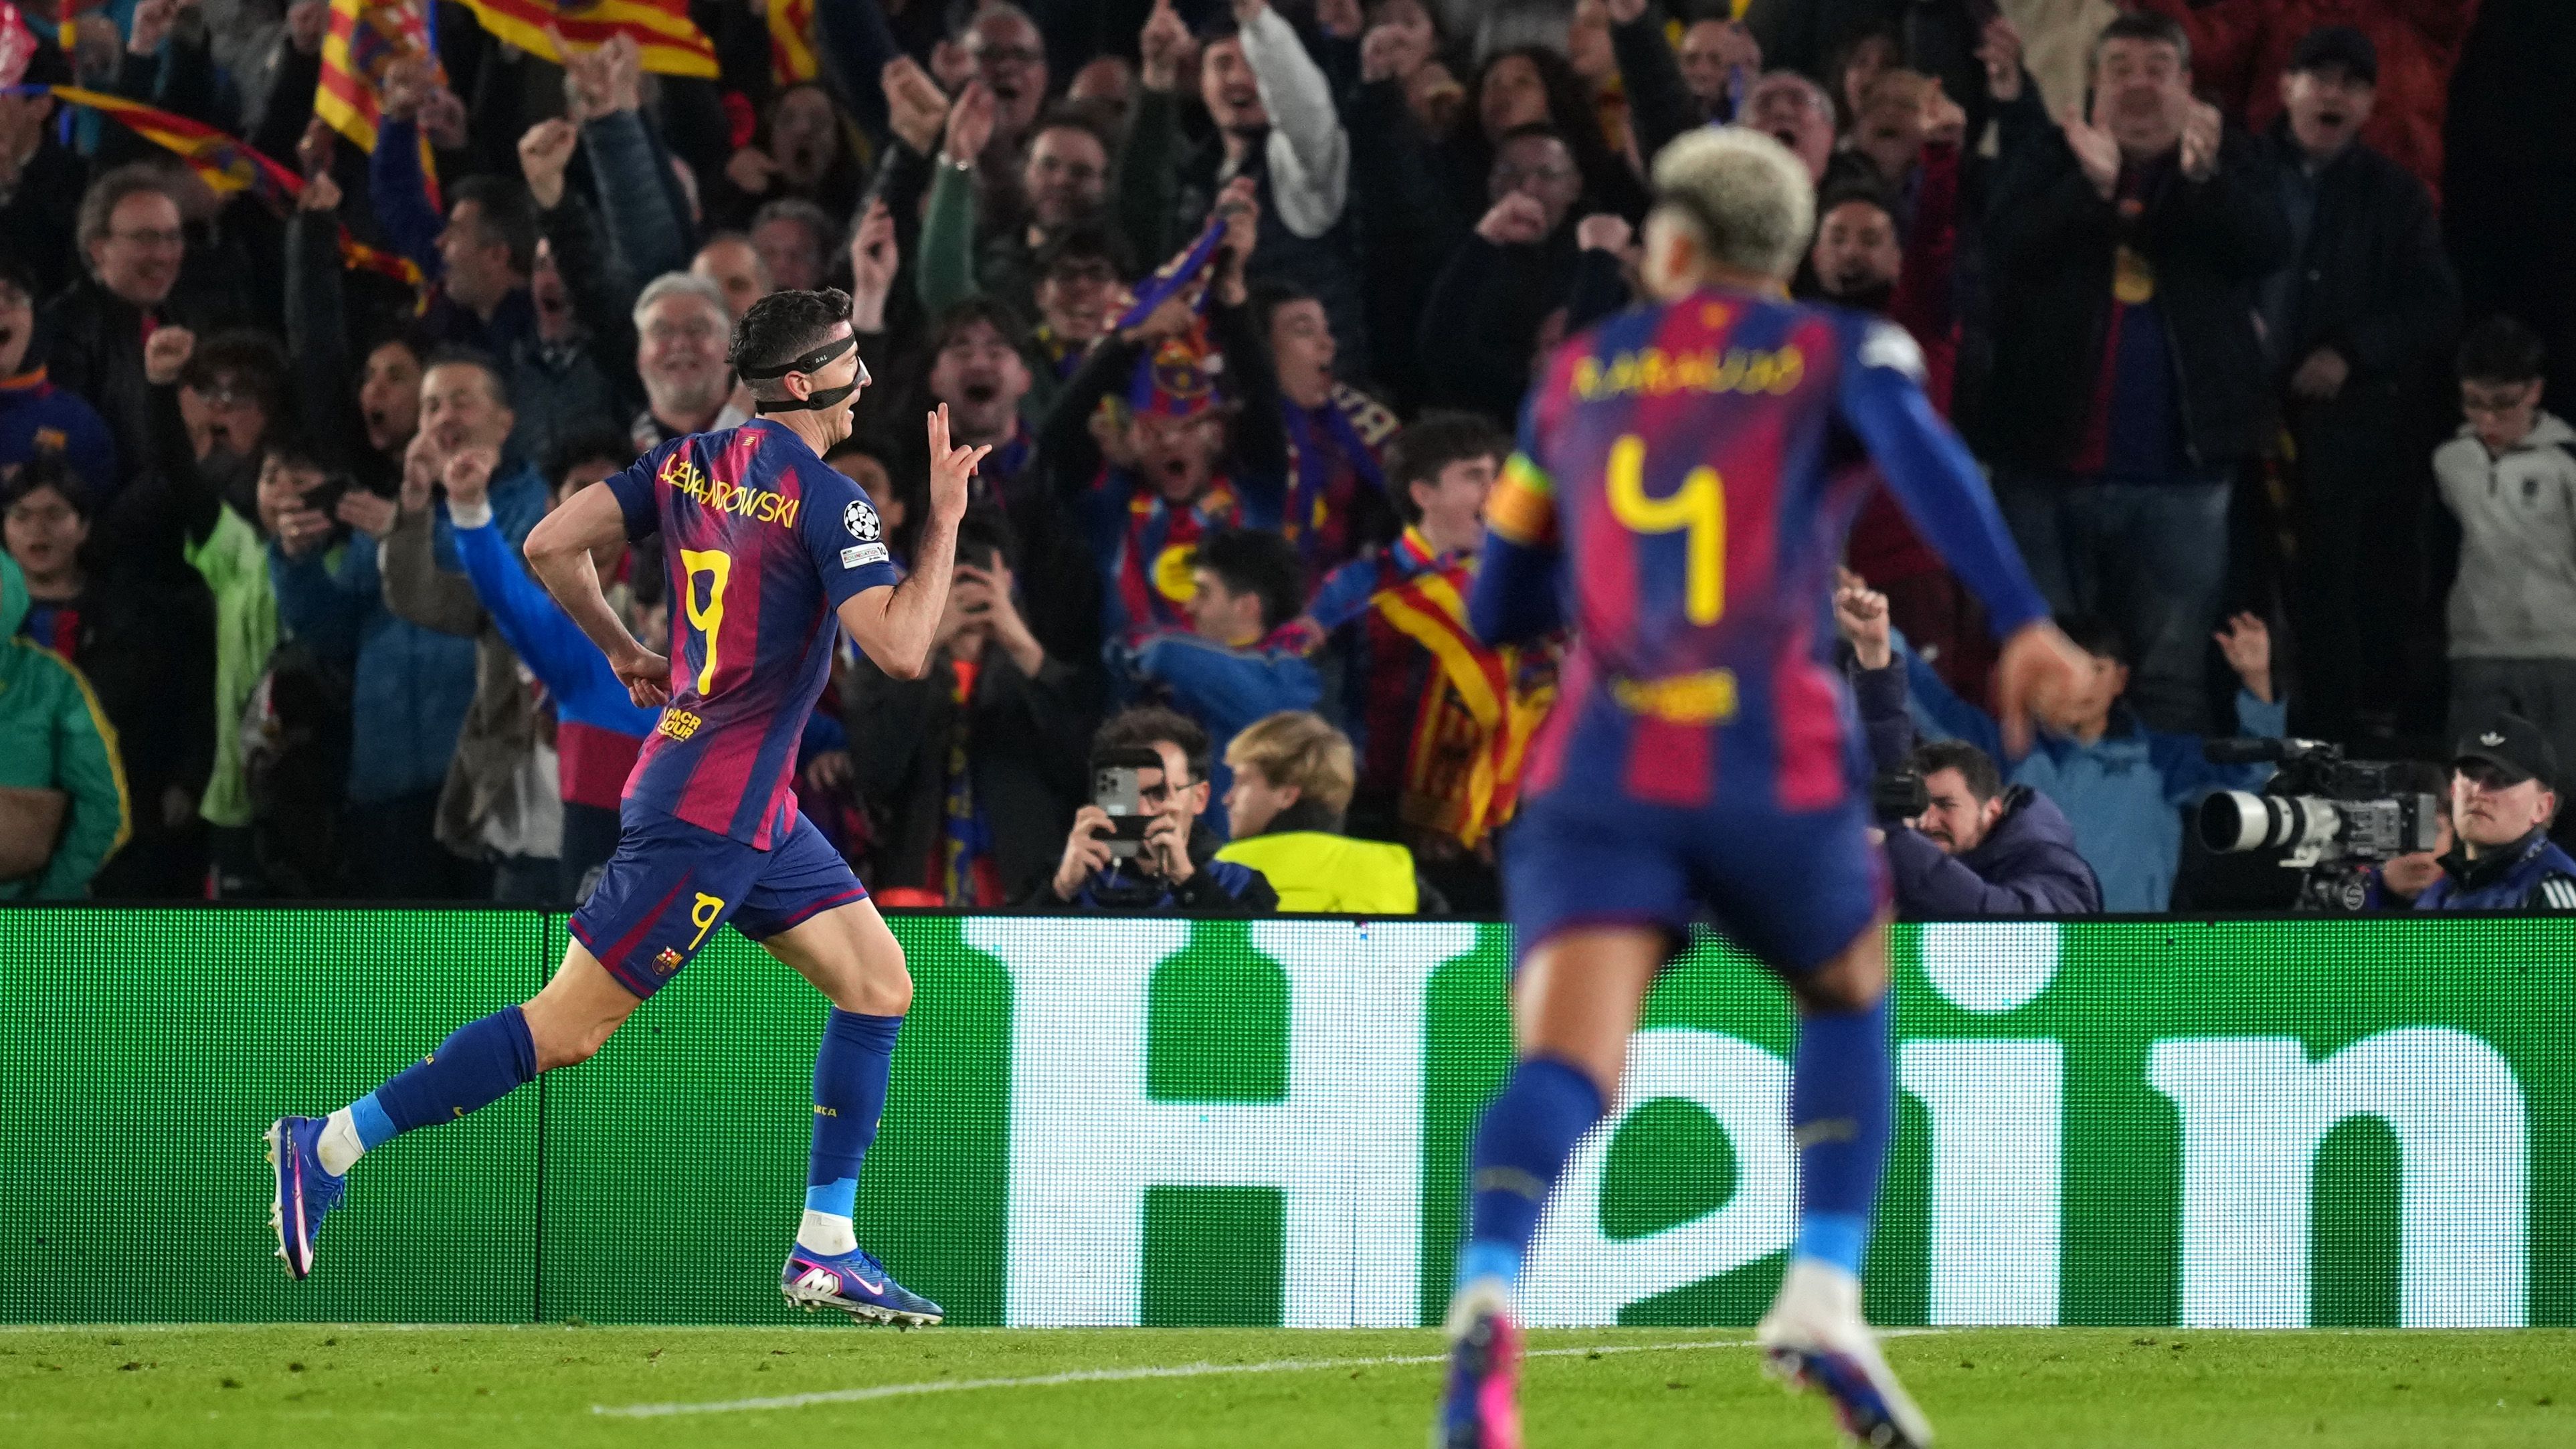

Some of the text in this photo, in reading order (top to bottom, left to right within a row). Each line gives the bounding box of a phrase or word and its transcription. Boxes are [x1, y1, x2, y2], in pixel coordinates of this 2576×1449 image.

[1607, 433, 1726, 626] 4
[680, 549, 731, 695] 9
[688, 892, 725, 951] 9
[959, 919, 2531, 1330] Hein
